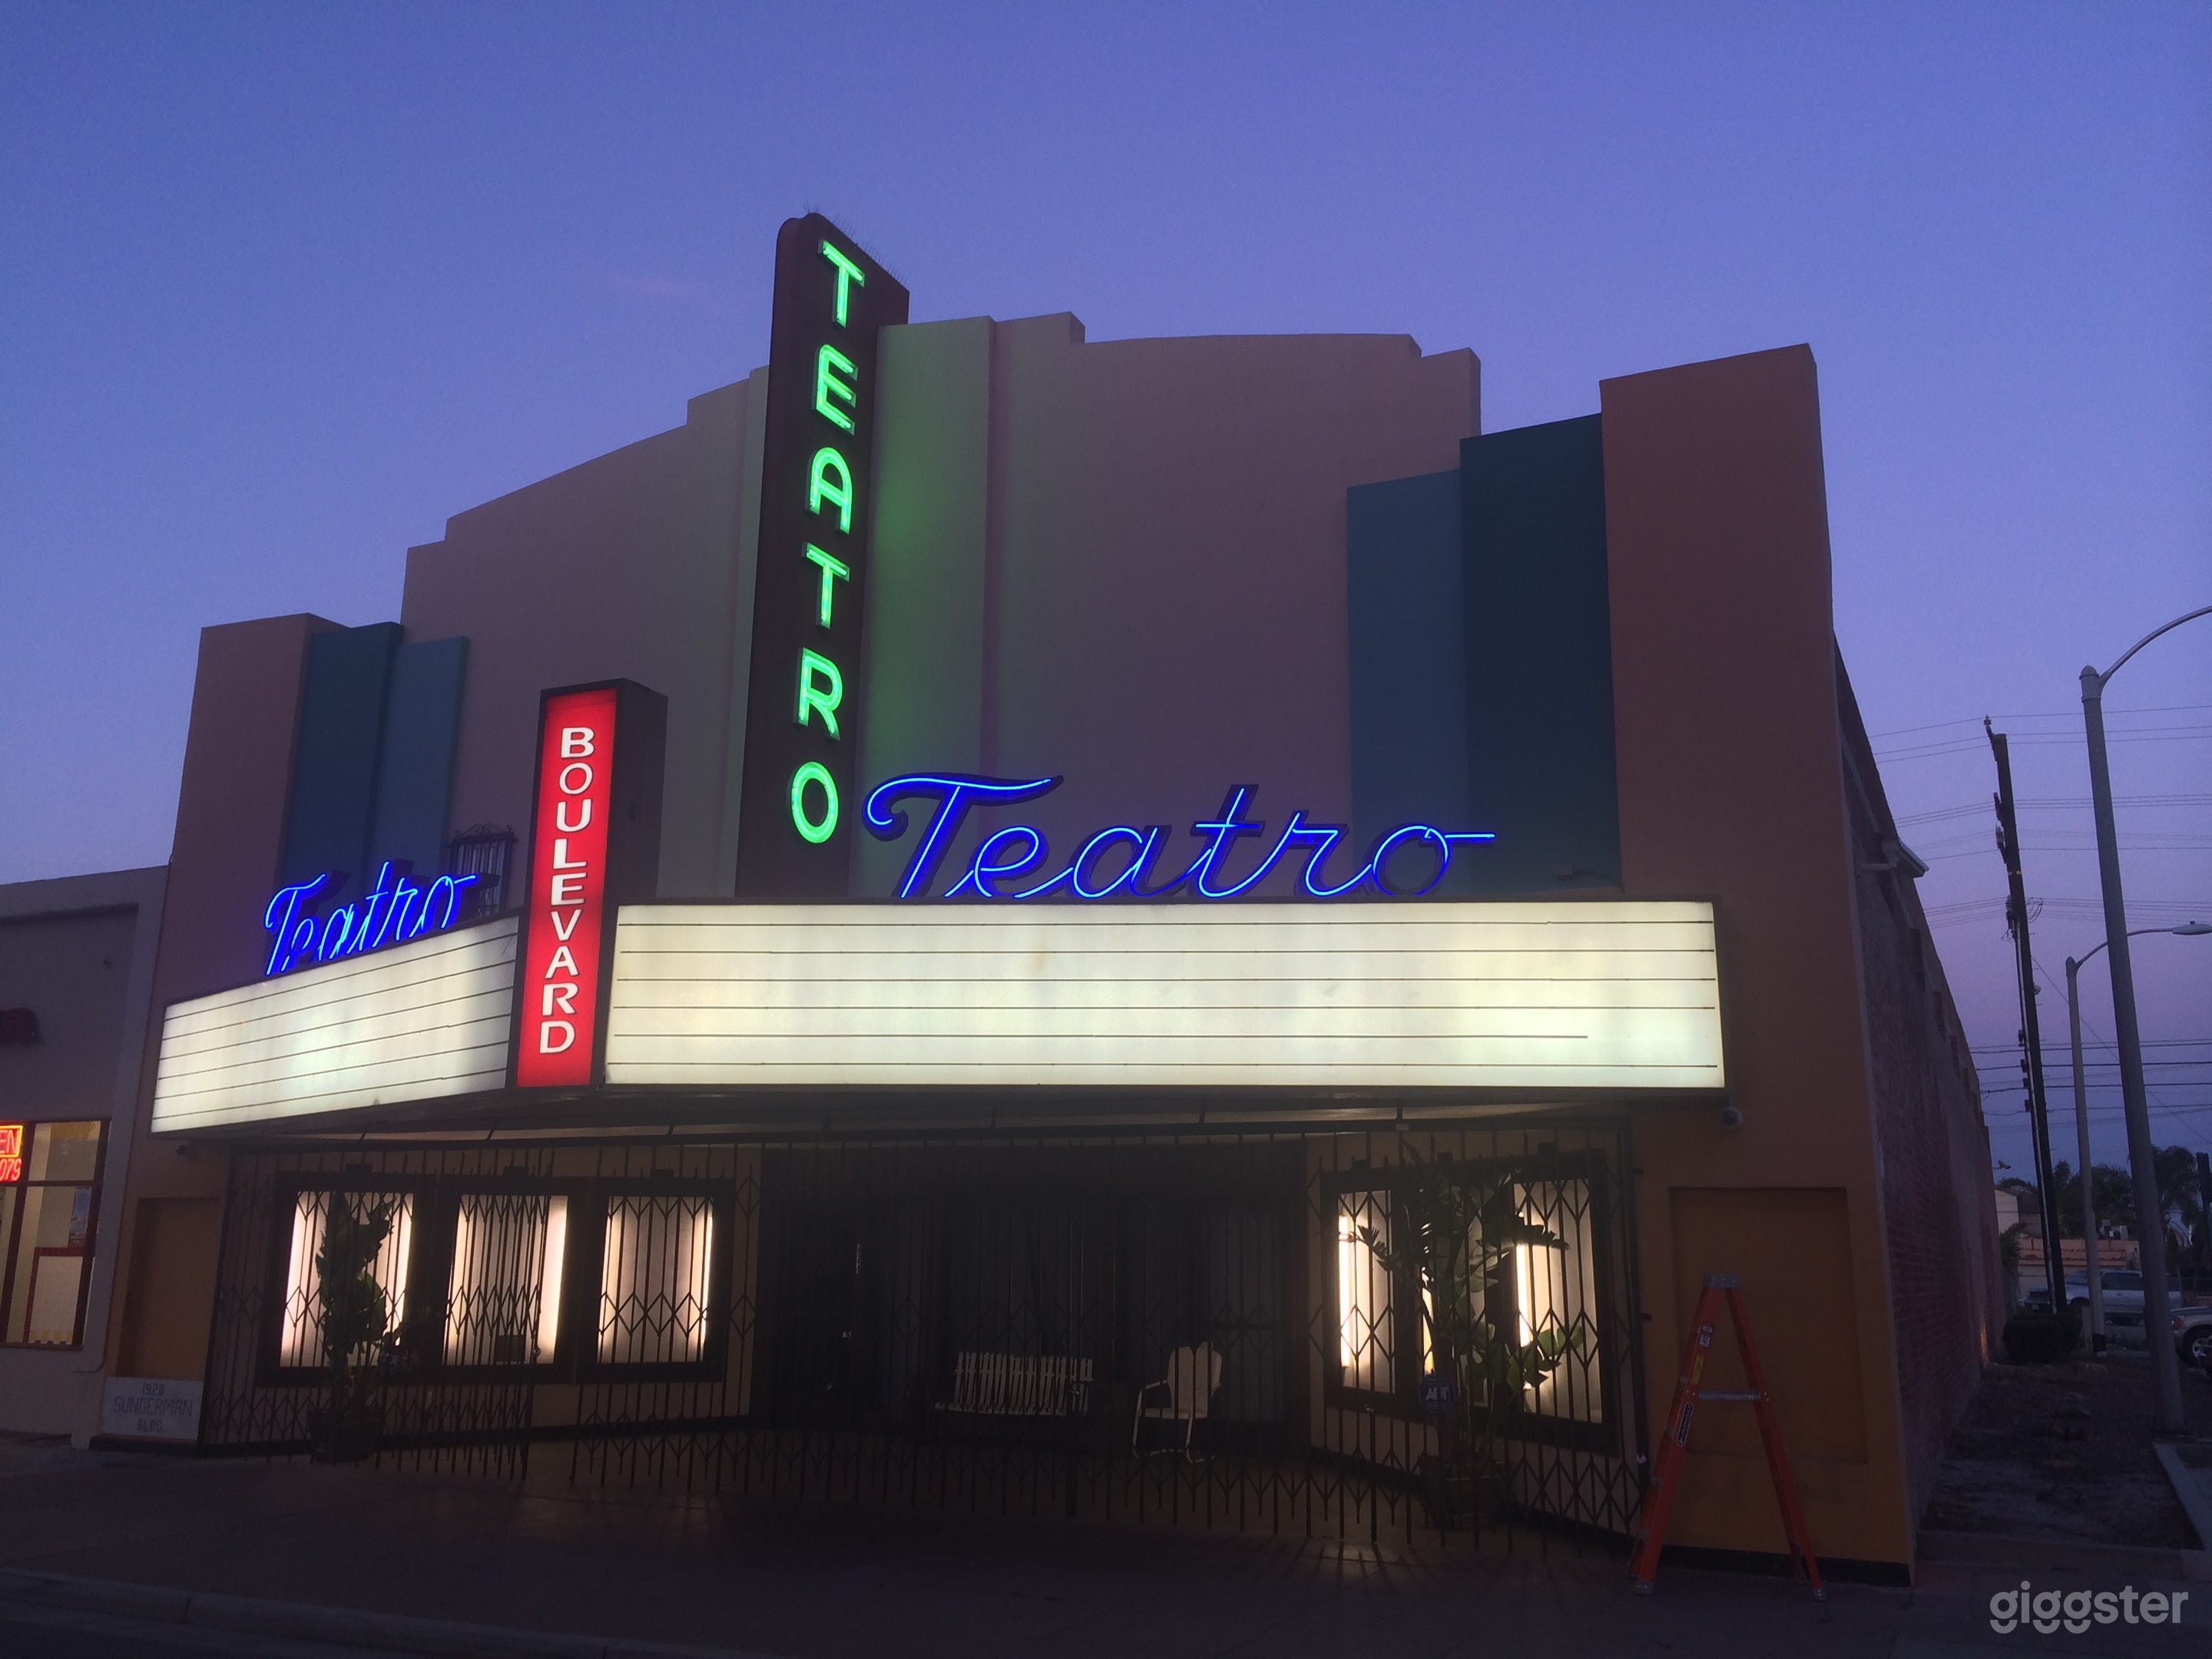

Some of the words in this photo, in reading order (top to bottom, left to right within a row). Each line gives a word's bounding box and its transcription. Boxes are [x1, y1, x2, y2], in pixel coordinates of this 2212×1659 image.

[788, 239, 865, 843] TEATRO
[263, 859, 479, 976] Teatro
[539, 727, 595, 1055] BOULEVARD
[862, 771, 1496, 899] Teatro
